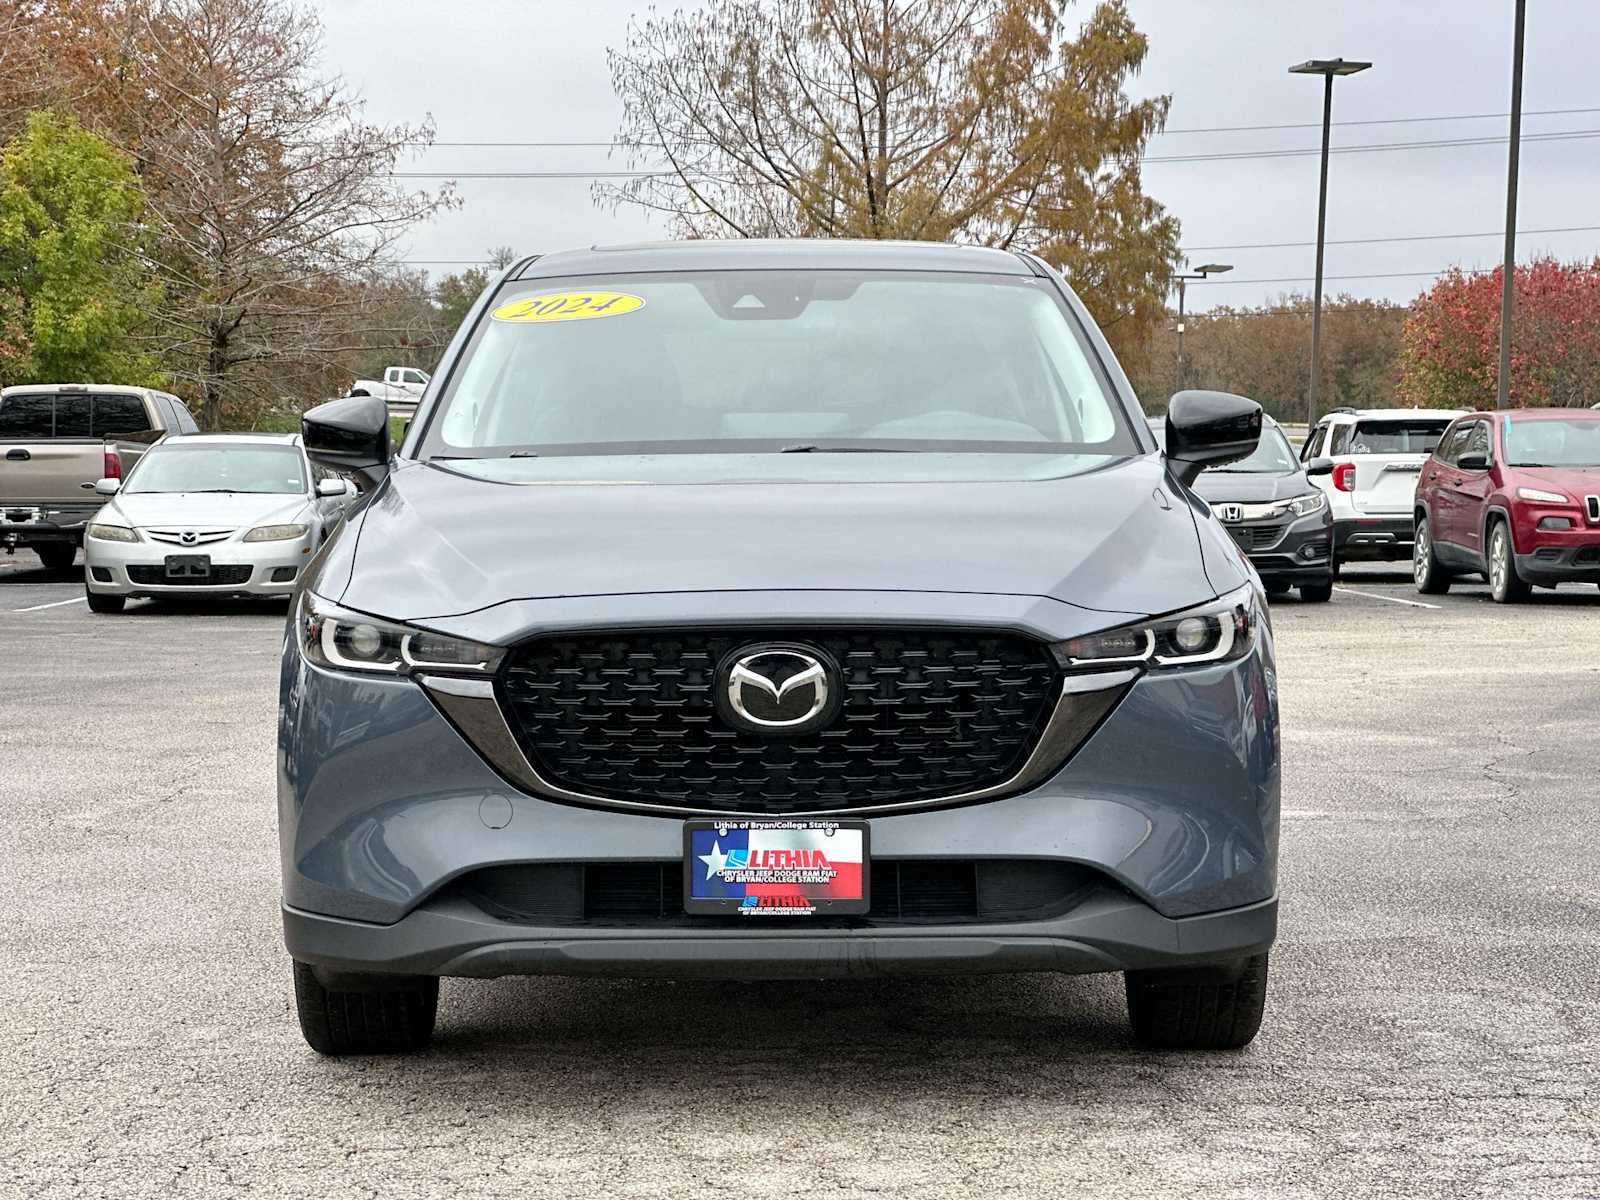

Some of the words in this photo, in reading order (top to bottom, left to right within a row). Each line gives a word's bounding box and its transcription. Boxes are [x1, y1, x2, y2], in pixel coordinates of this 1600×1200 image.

[507, 296, 624, 319] 2024
[714, 821, 738, 829] Lithia
[740, 821, 749, 829] of
[750, 821, 808, 830] Bryan/College
[809, 821, 839, 829] Station
[748, 849, 832, 870] LITHIA
[759, 896, 811, 907] LITHIA
